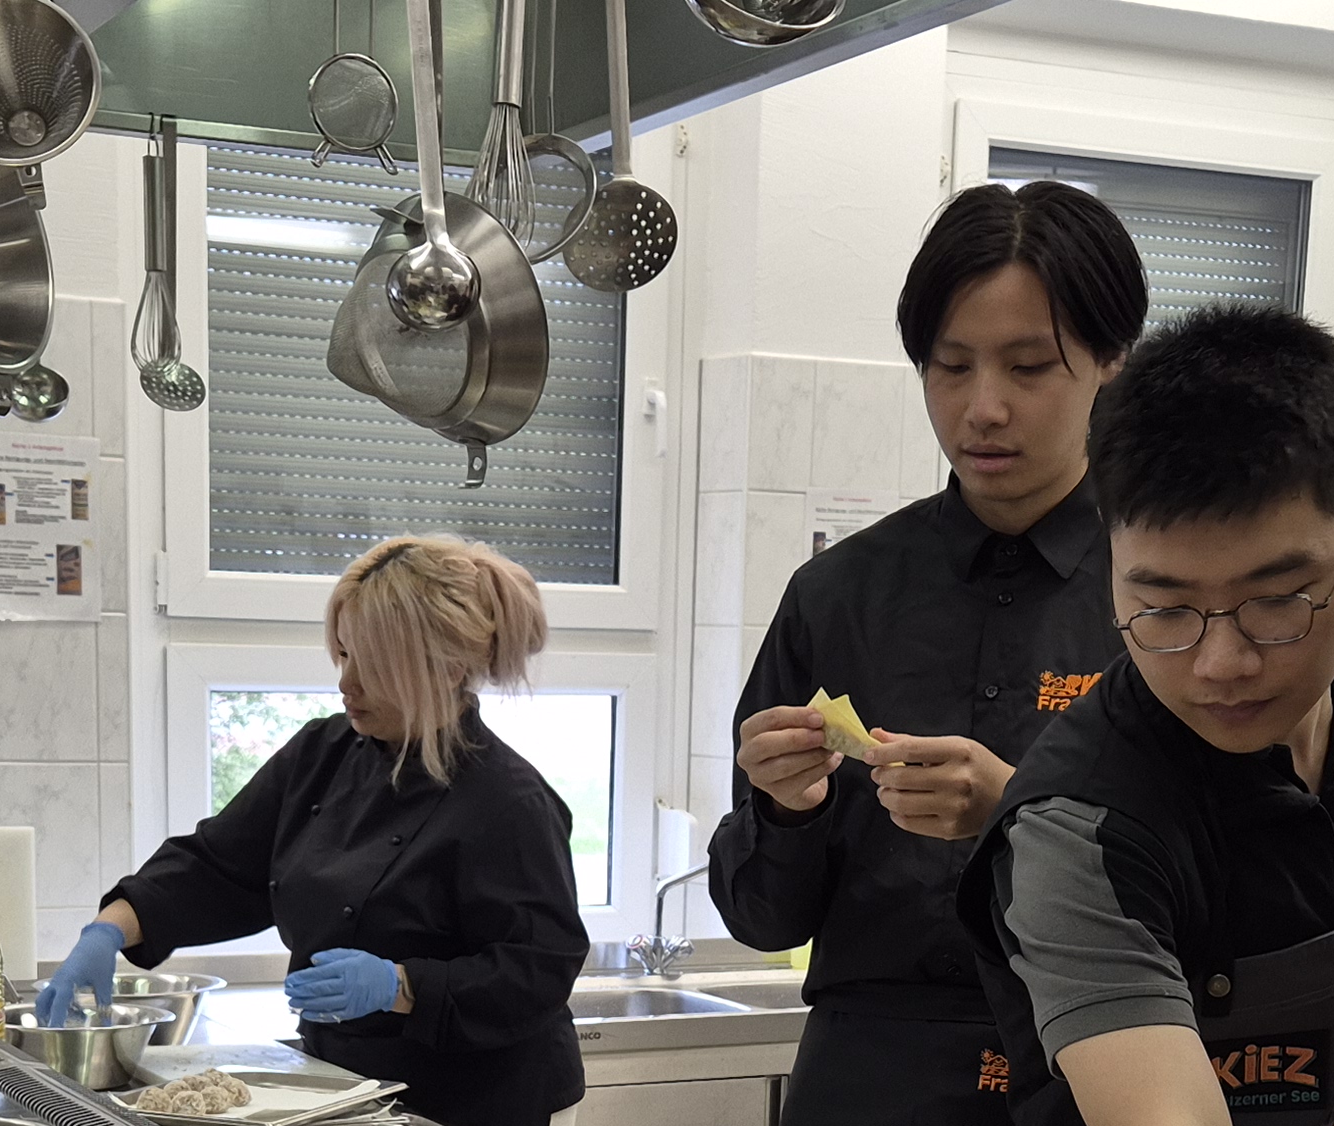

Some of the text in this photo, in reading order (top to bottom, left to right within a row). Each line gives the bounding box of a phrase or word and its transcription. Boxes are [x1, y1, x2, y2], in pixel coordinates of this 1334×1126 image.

[578, 1031, 602, 1041] NCO
[1211, 1044, 1318, 1089] KiEZ
[1228, 1089, 1320, 1107] lzerner See
